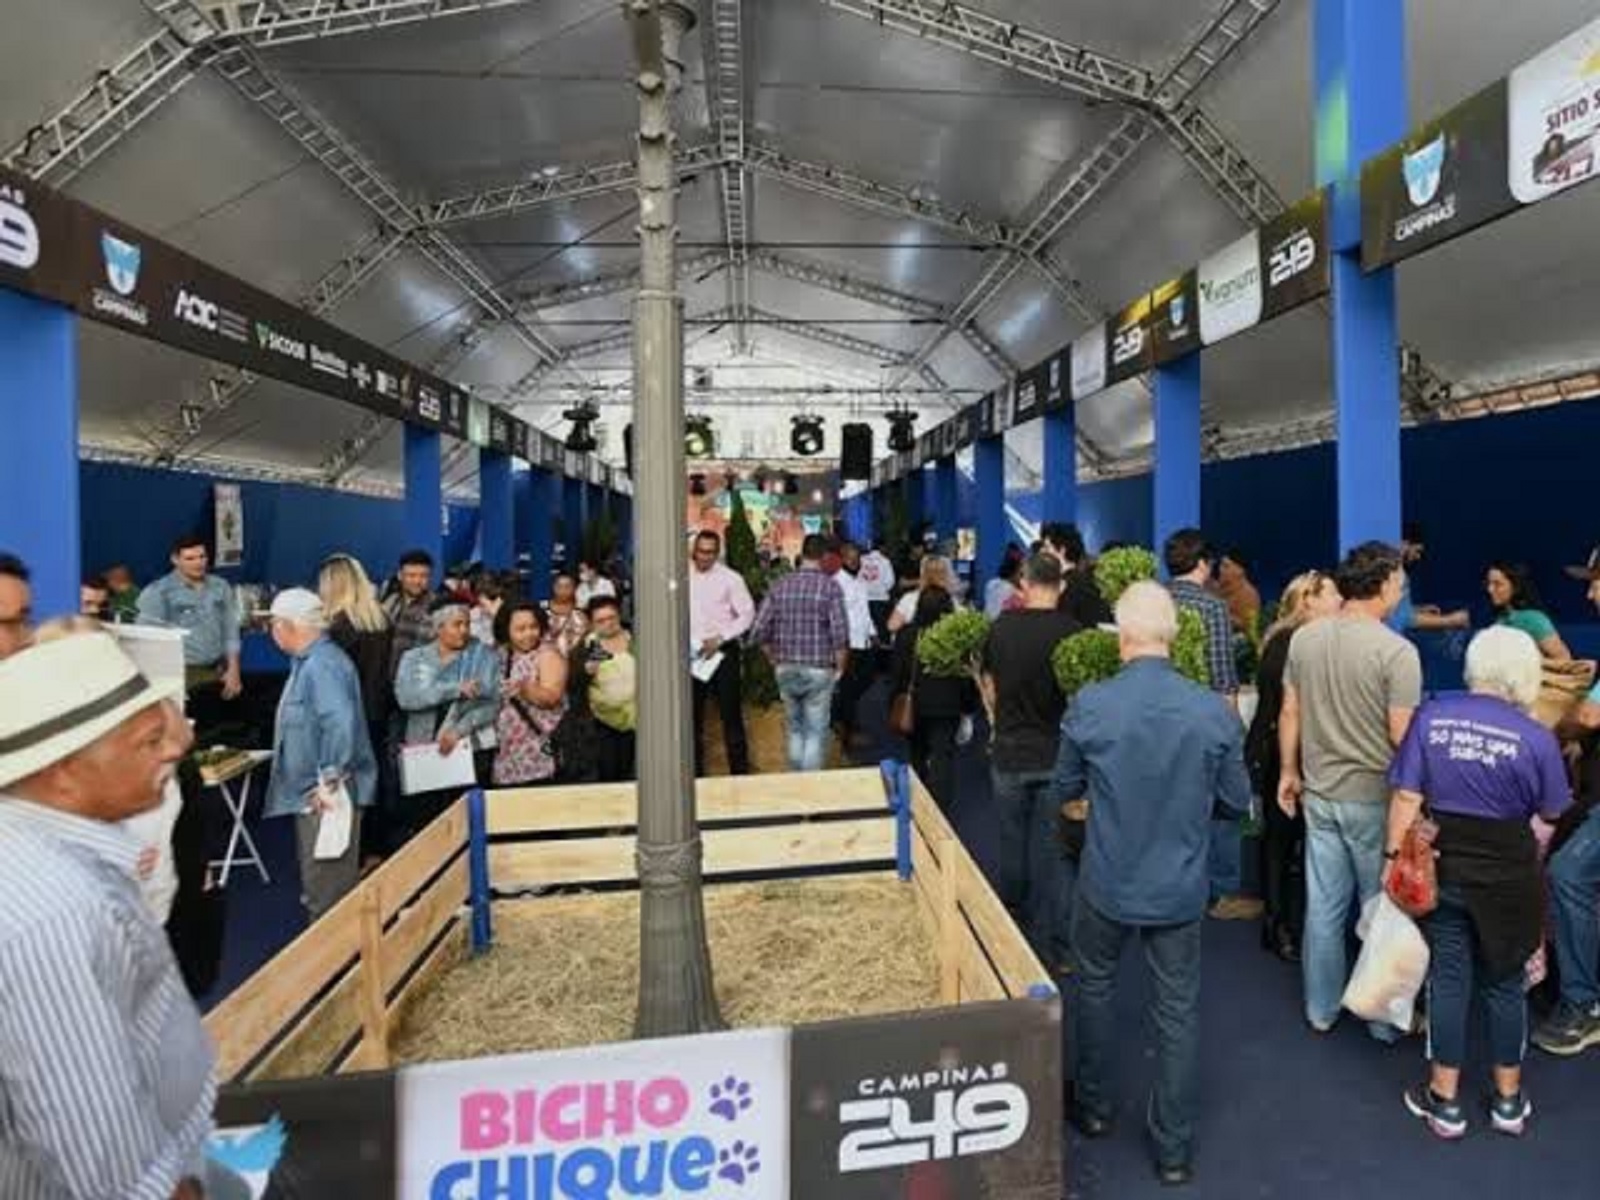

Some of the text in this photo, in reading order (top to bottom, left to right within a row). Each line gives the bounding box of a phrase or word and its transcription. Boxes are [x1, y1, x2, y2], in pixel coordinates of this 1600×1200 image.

[1268, 236, 1316, 287] 249
[857, 1061, 1009, 1096] CAMPINAS
[459, 1077, 691, 1152] BICHO
[838, 1081, 1030, 1173] 249
